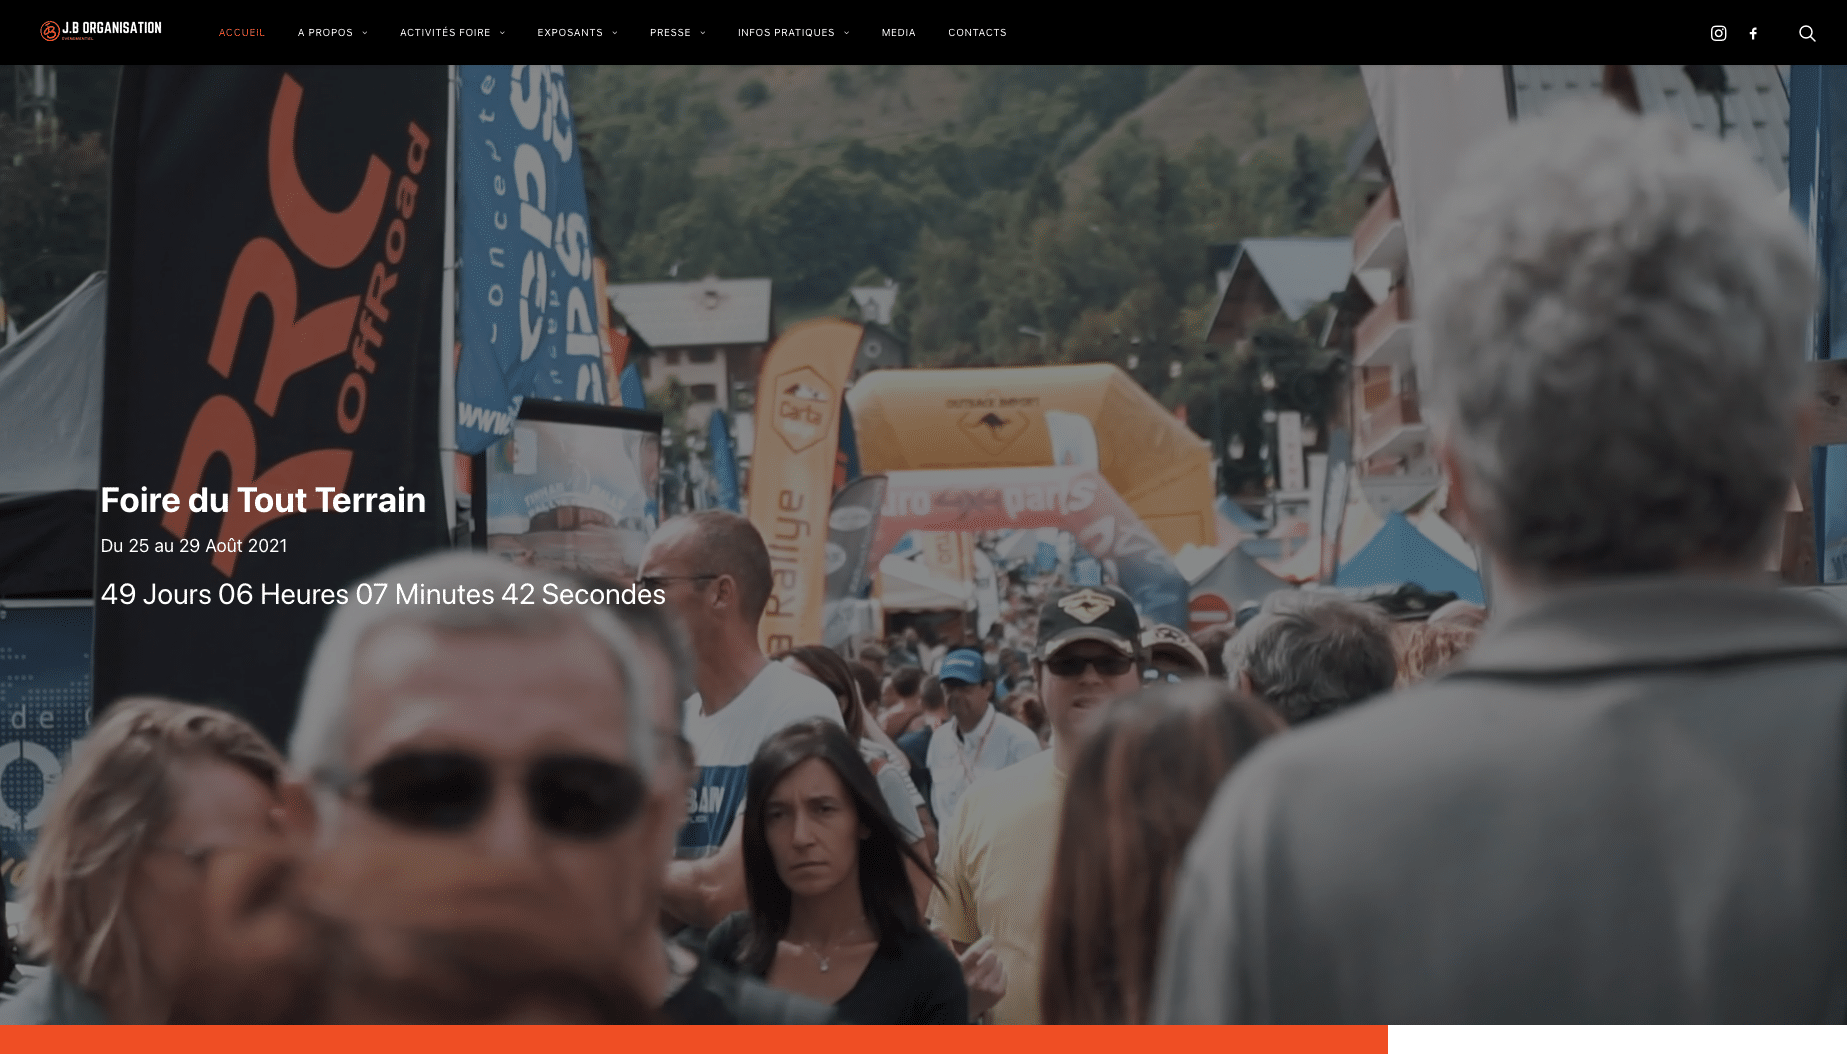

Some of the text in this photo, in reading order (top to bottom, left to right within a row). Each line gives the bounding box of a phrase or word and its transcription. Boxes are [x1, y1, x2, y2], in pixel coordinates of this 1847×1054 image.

[161, 73, 392, 578] RRC
[337, 121, 431, 434] OffRoad
[780, 401, 822, 426] Carta
